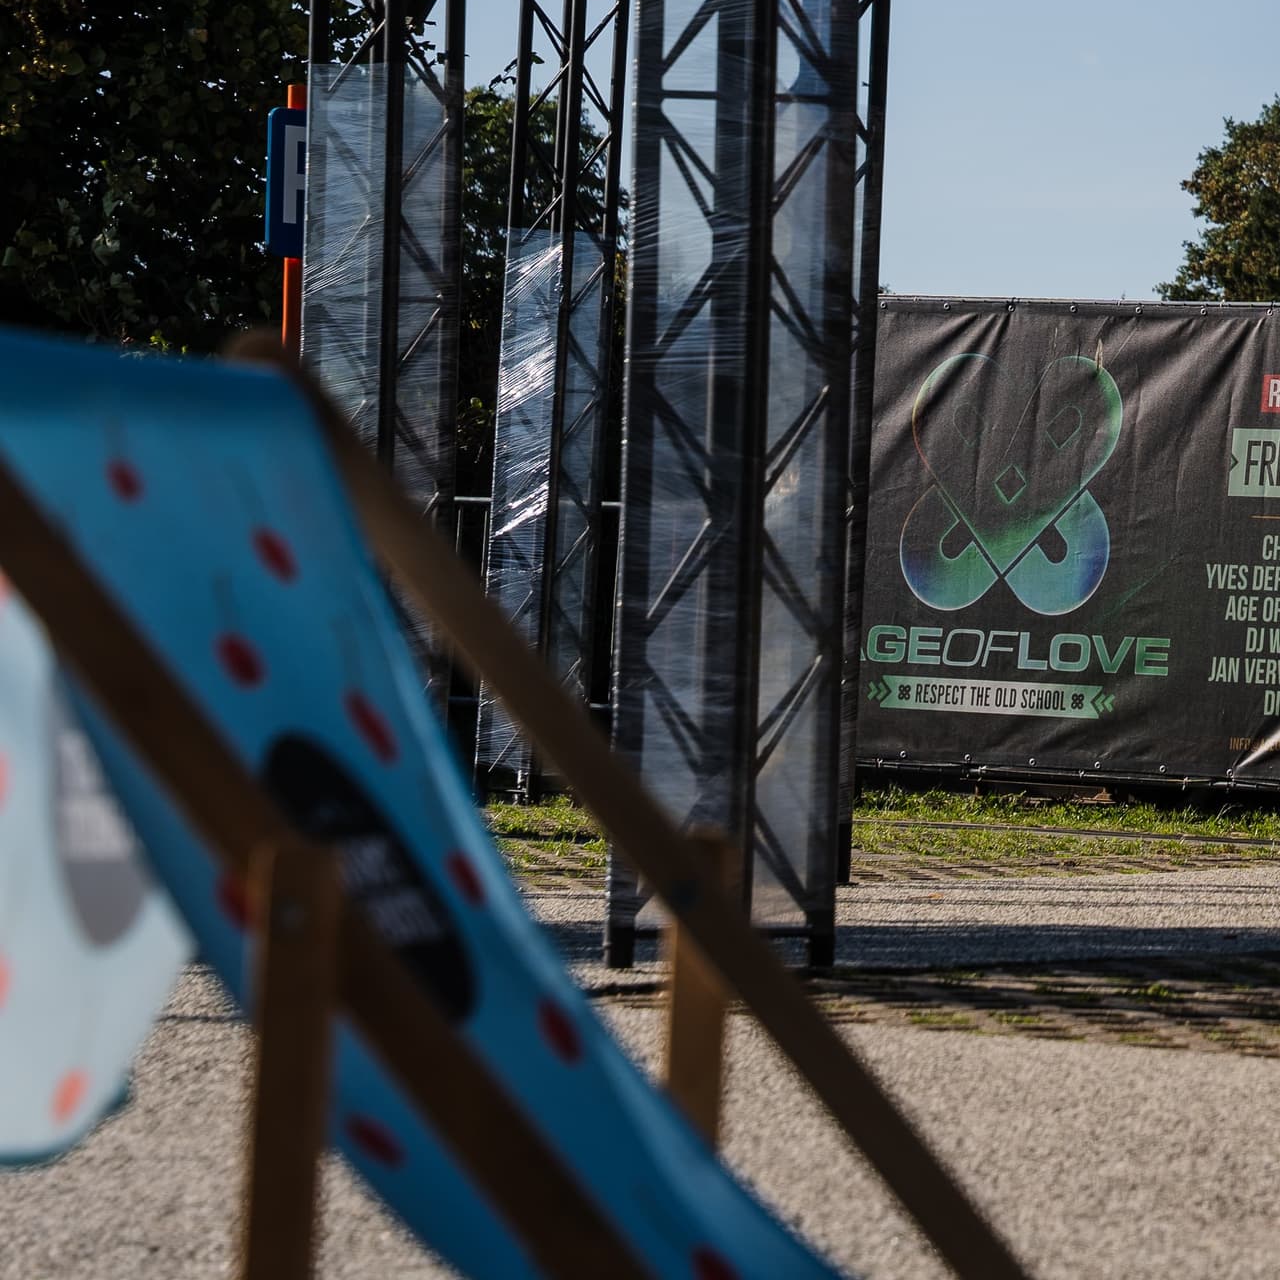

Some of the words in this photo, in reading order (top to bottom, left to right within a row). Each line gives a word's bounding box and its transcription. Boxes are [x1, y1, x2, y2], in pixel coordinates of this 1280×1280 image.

[1206, 563, 1249, 590] YVES
[1224, 595, 1259, 622] AGE
[860, 624, 1171, 676] GEOFLOVE
[1245, 627, 1265, 653] DJ
[1208, 657, 1240, 684] JAN
[914, 683, 966, 705] RESPECT
[969, 685, 991, 707] THE
[995, 687, 1016, 708] OLD
[1020, 689, 1067, 711] SCHOOL
